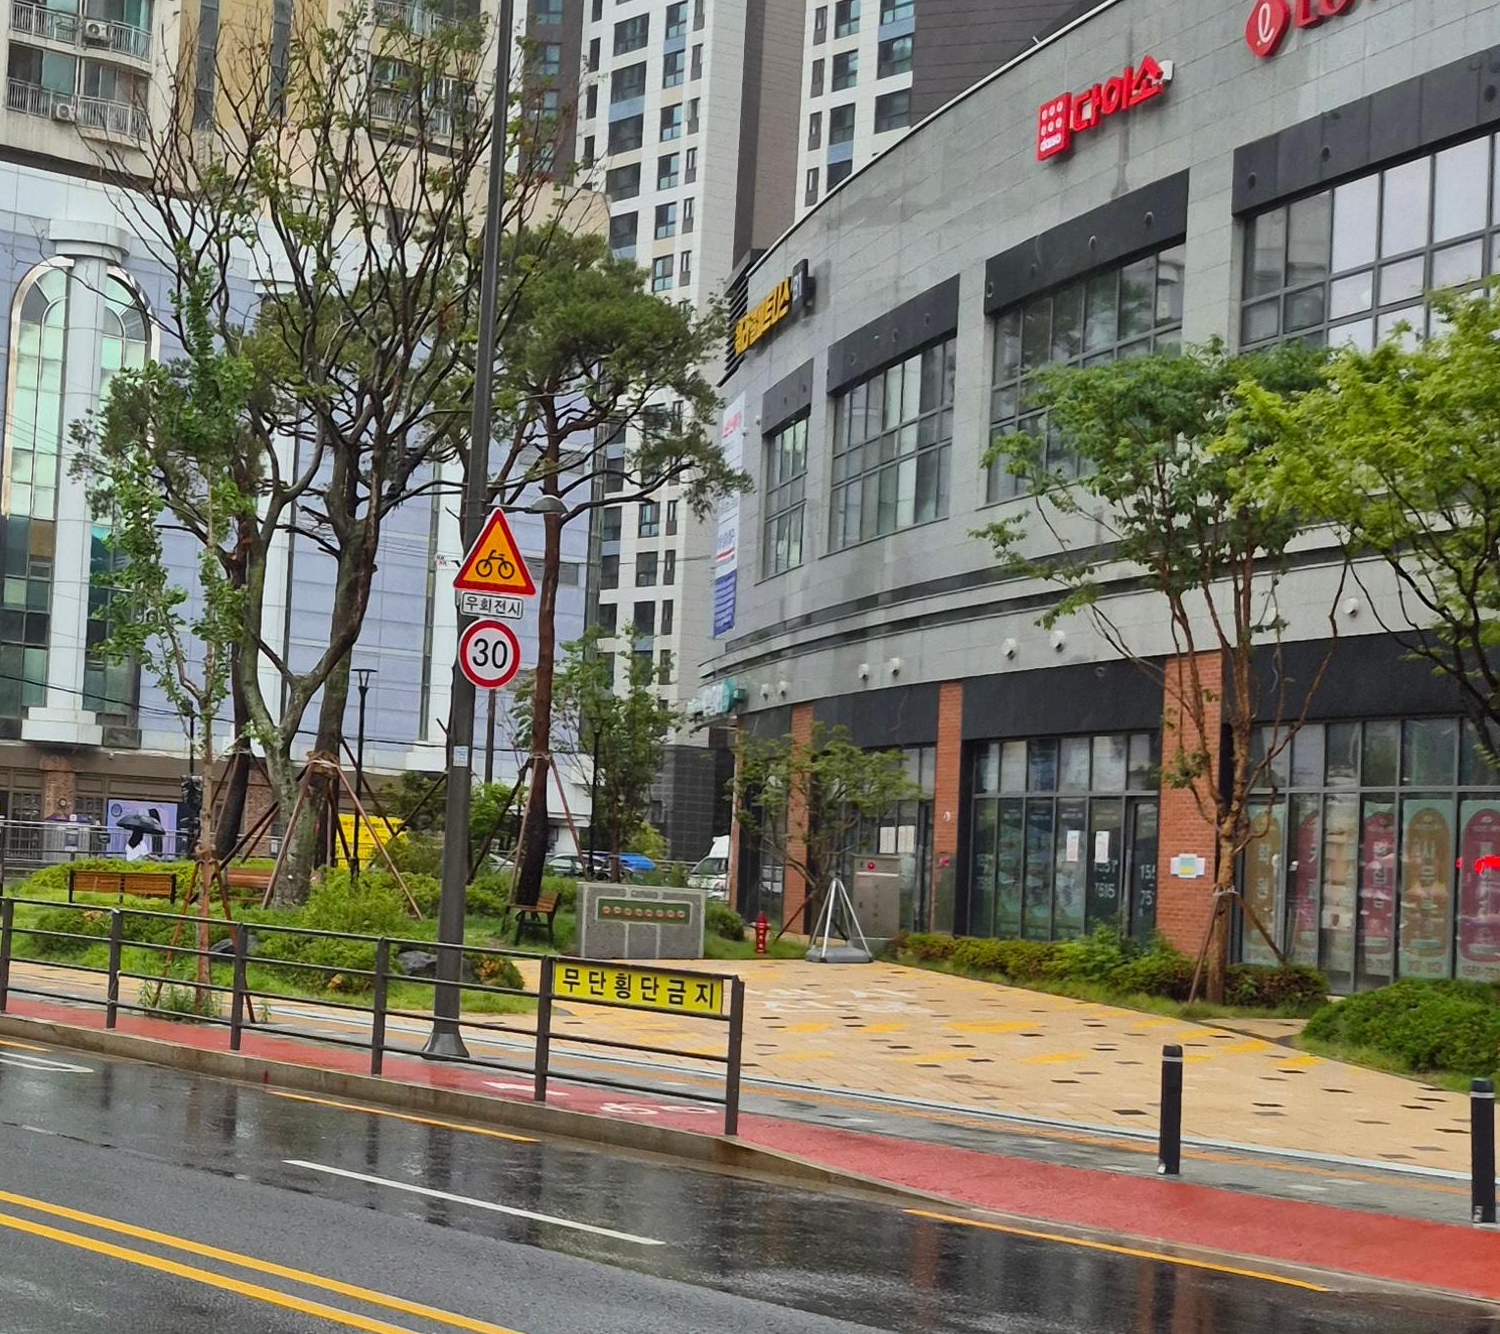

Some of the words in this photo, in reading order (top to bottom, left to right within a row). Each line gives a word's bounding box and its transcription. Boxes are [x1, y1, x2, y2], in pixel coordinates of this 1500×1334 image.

[1071, 54, 1164, 131] 다이소
[464, 597, 522, 617] 우회전시
[472, 638, 508, 669] 30
[562, 968, 714, 1009] 무단횡단금지
